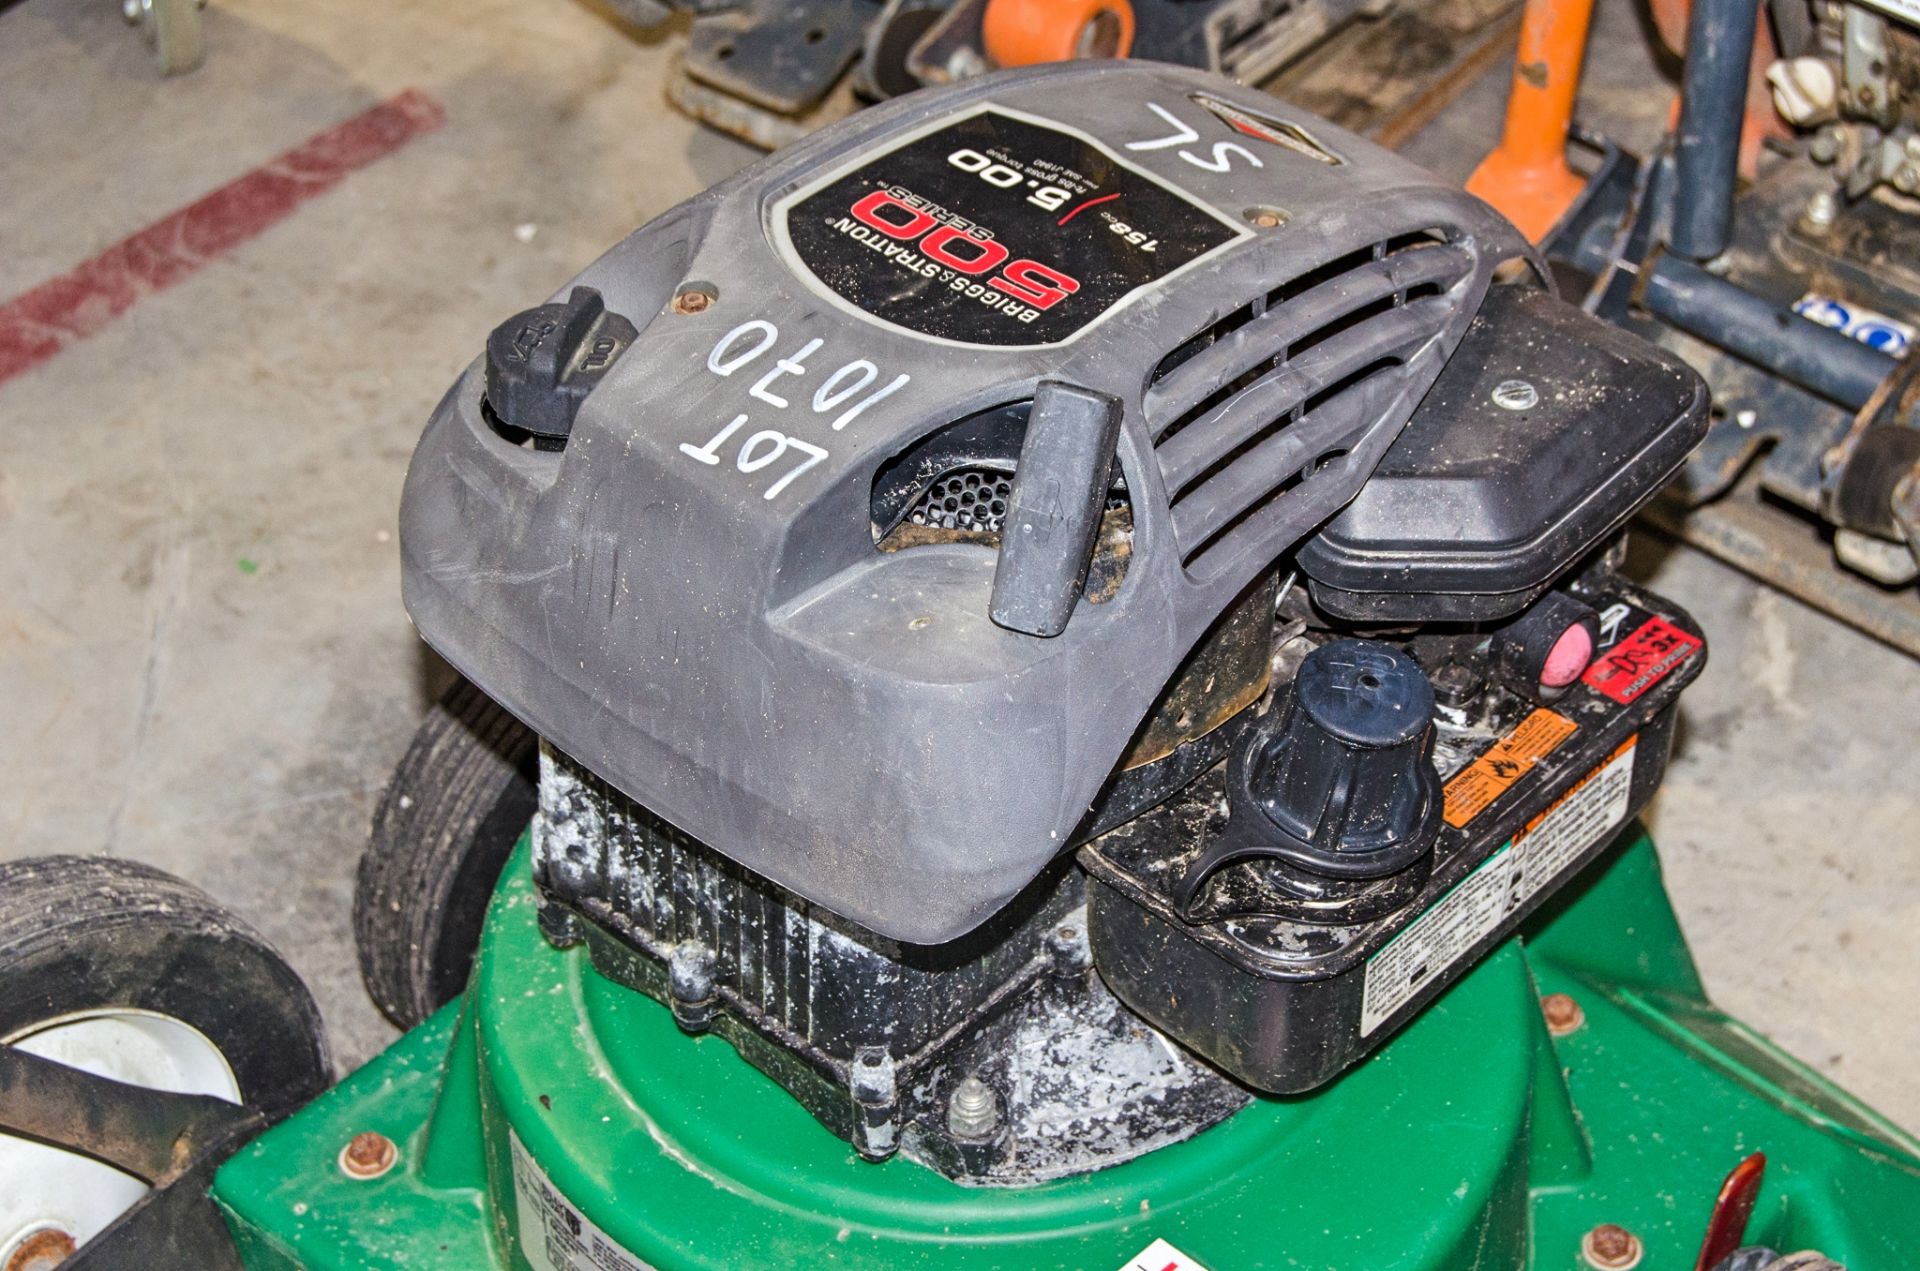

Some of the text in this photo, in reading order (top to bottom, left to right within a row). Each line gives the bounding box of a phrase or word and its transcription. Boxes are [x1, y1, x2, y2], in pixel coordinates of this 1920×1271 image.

[985, 149, 1023, 170] torque
[1125, 102, 1263, 173] SL
[947, 148, 1072, 213] 5.00
[1024, 166, 1057, 182] gross
[850, 187, 1081, 311] 500
[707, 320, 911, 431] 1070
[679, 414, 829, 500] LOT
[1622, 675, 1650, 696] PUSH
[1648, 665, 1664, 676] TO
